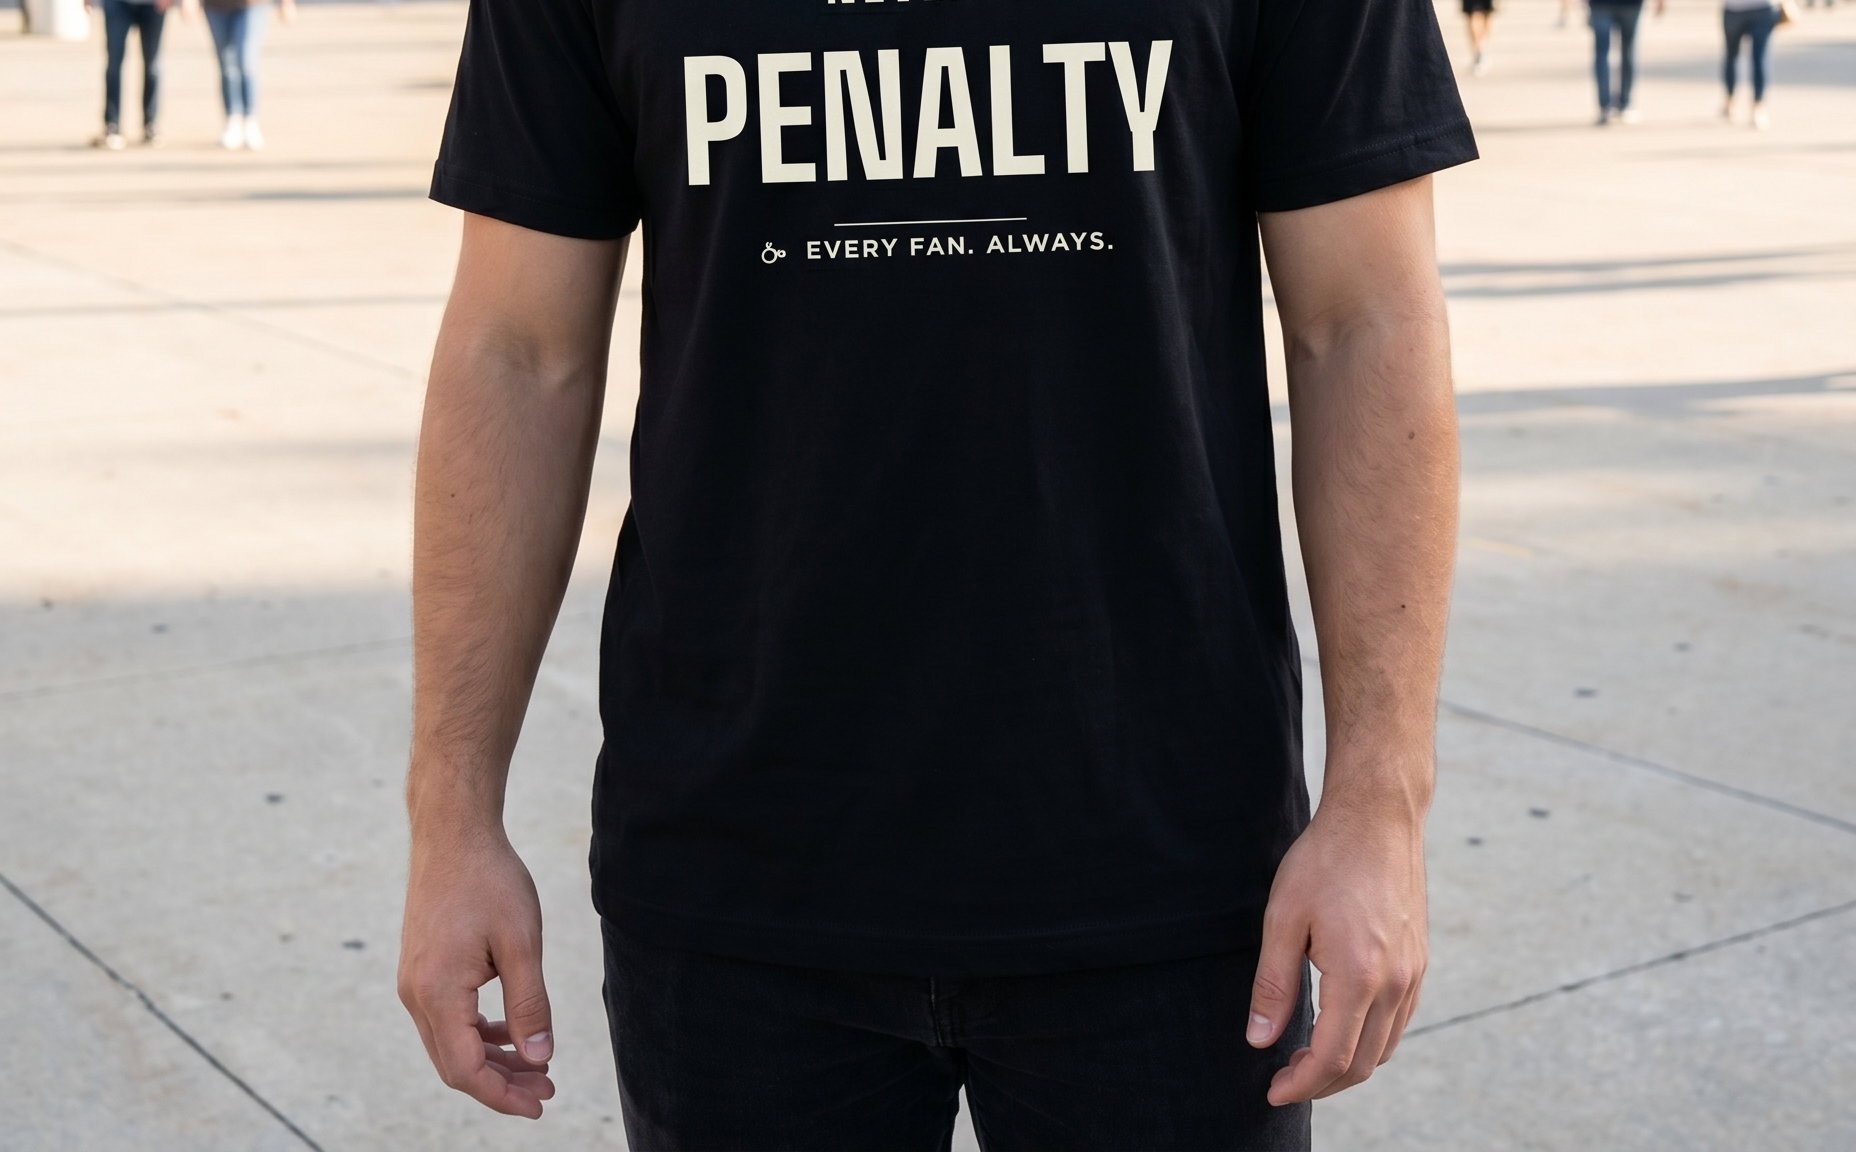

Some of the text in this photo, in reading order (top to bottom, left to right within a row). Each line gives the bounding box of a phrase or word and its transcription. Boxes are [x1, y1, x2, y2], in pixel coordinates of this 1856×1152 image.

[684, 40, 1173, 185] PENALTY
[806, 231, 1114, 260] EVERY FAN. ALWAYS.
